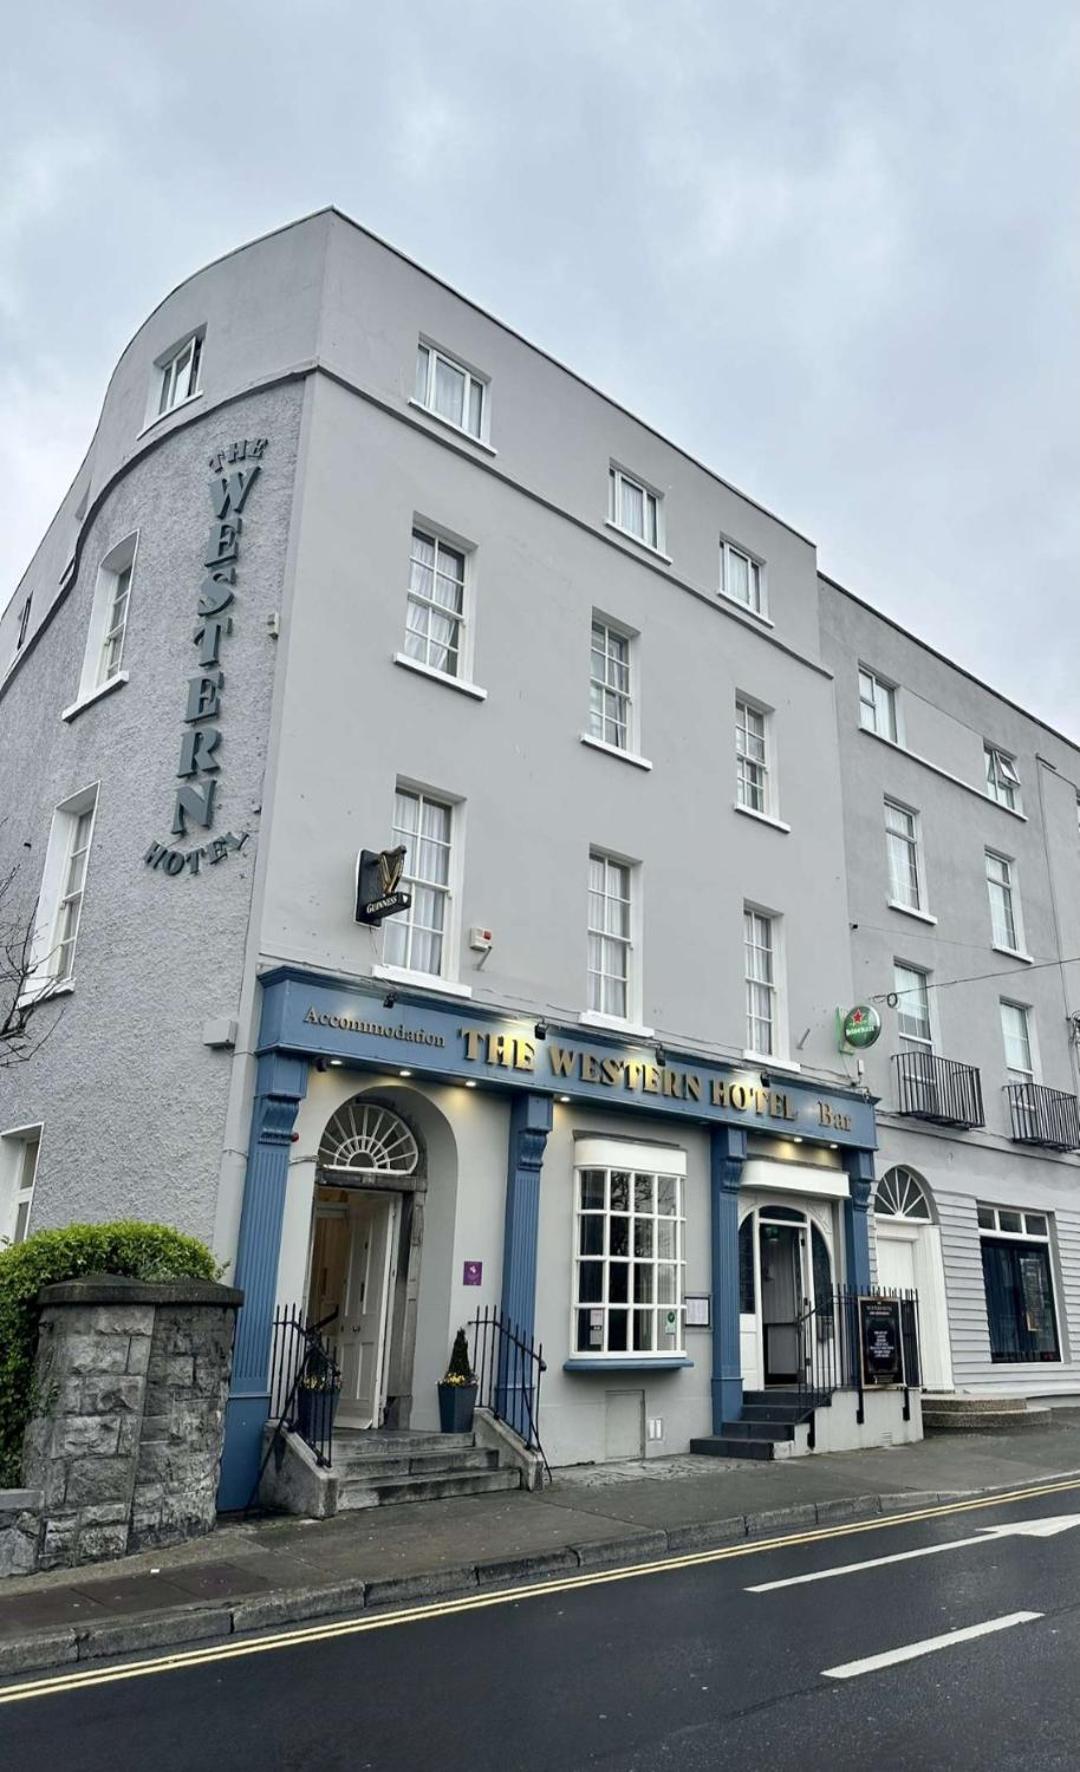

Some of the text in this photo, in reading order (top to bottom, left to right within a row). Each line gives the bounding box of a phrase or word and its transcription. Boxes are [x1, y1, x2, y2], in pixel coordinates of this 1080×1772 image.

[208, 439, 268, 473] THE
[171, 466, 261, 835] WESTERN
[143, 832, 250, 876] HOTEL
[303, 1005, 446, 1048] Accommodation
[457, 1025, 799, 1121] THE WESTERN HOTEL
[817, 1100, 852, 1132] Bar
